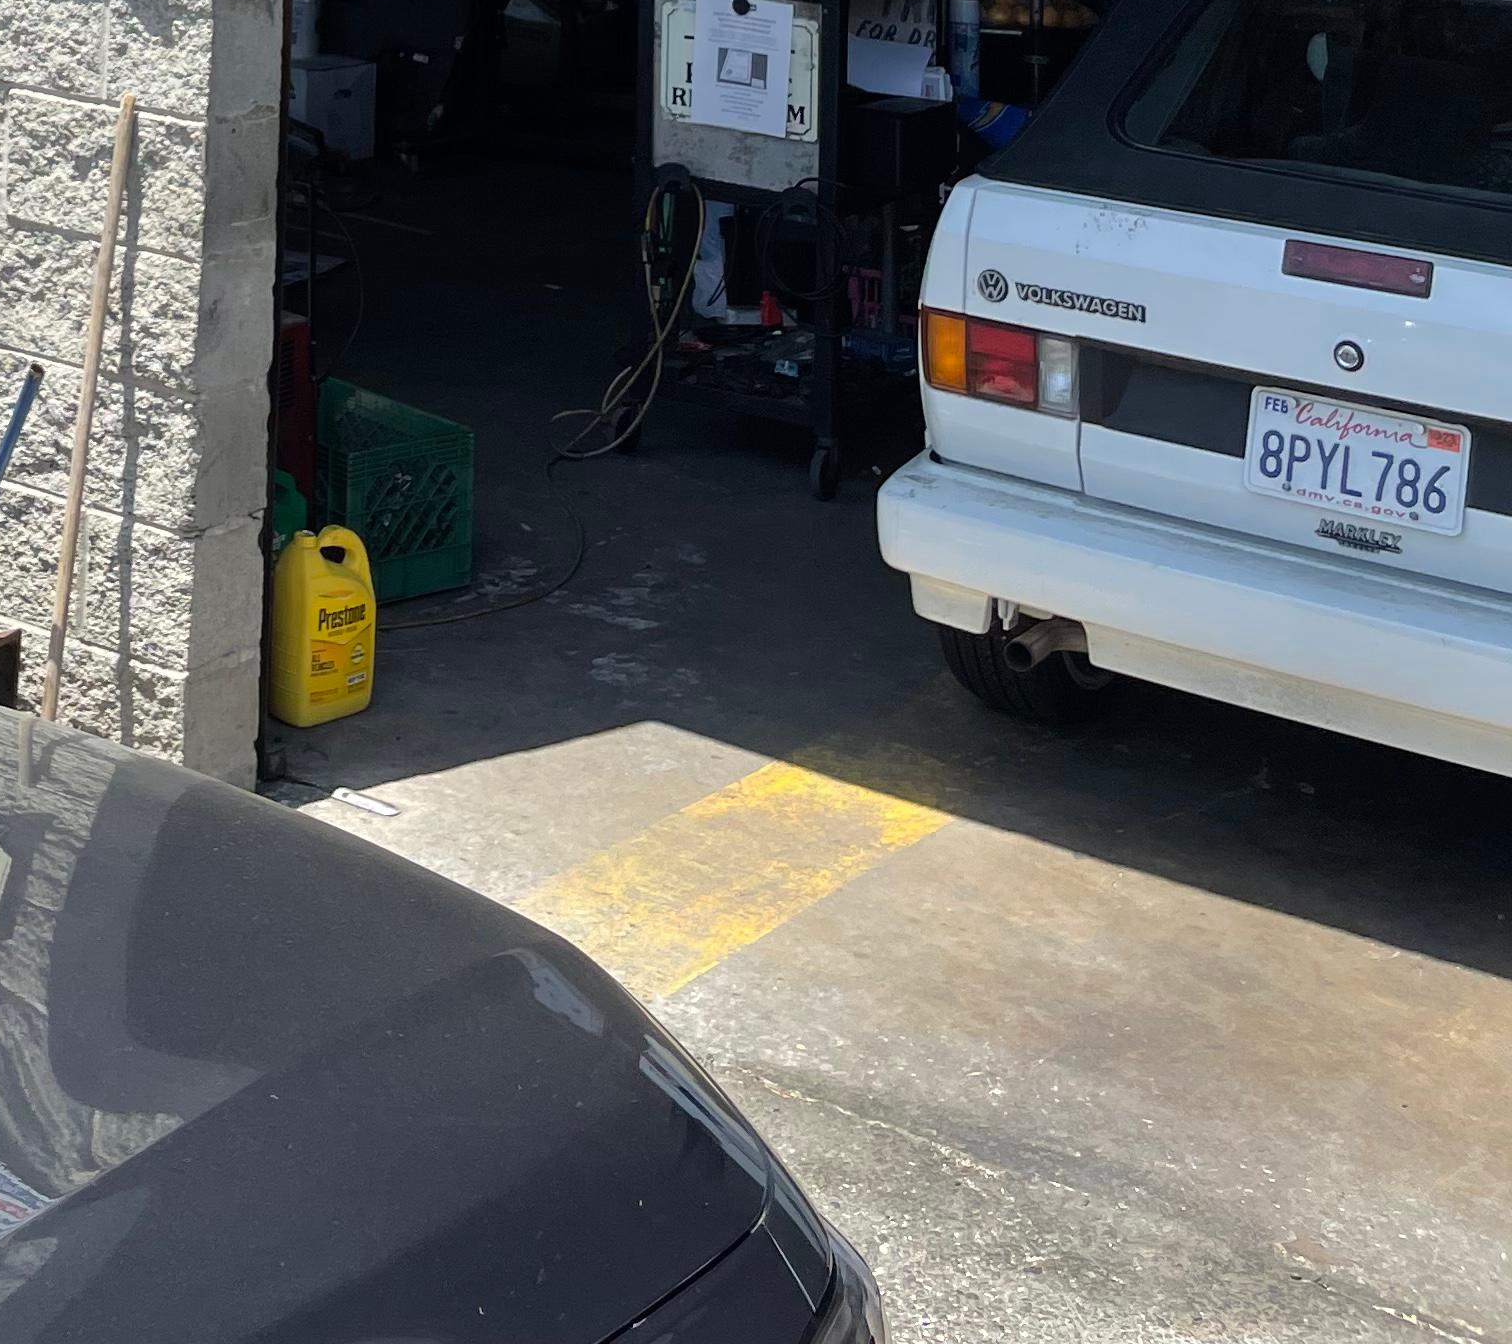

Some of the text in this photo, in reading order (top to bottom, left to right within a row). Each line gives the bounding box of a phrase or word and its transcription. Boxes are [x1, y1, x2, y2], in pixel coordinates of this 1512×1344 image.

[1015, 282, 1146, 323] VOLKSWAGEN
[1296, 402, 1426, 448] California
[1259, 429, 1451, 514] 8PYL786
[1296, 488, 1406, 518] dmv.ca.gov
[1317, 519, 1402, 550] MARKLEY
[318, 603, 366, 631] Prestone
